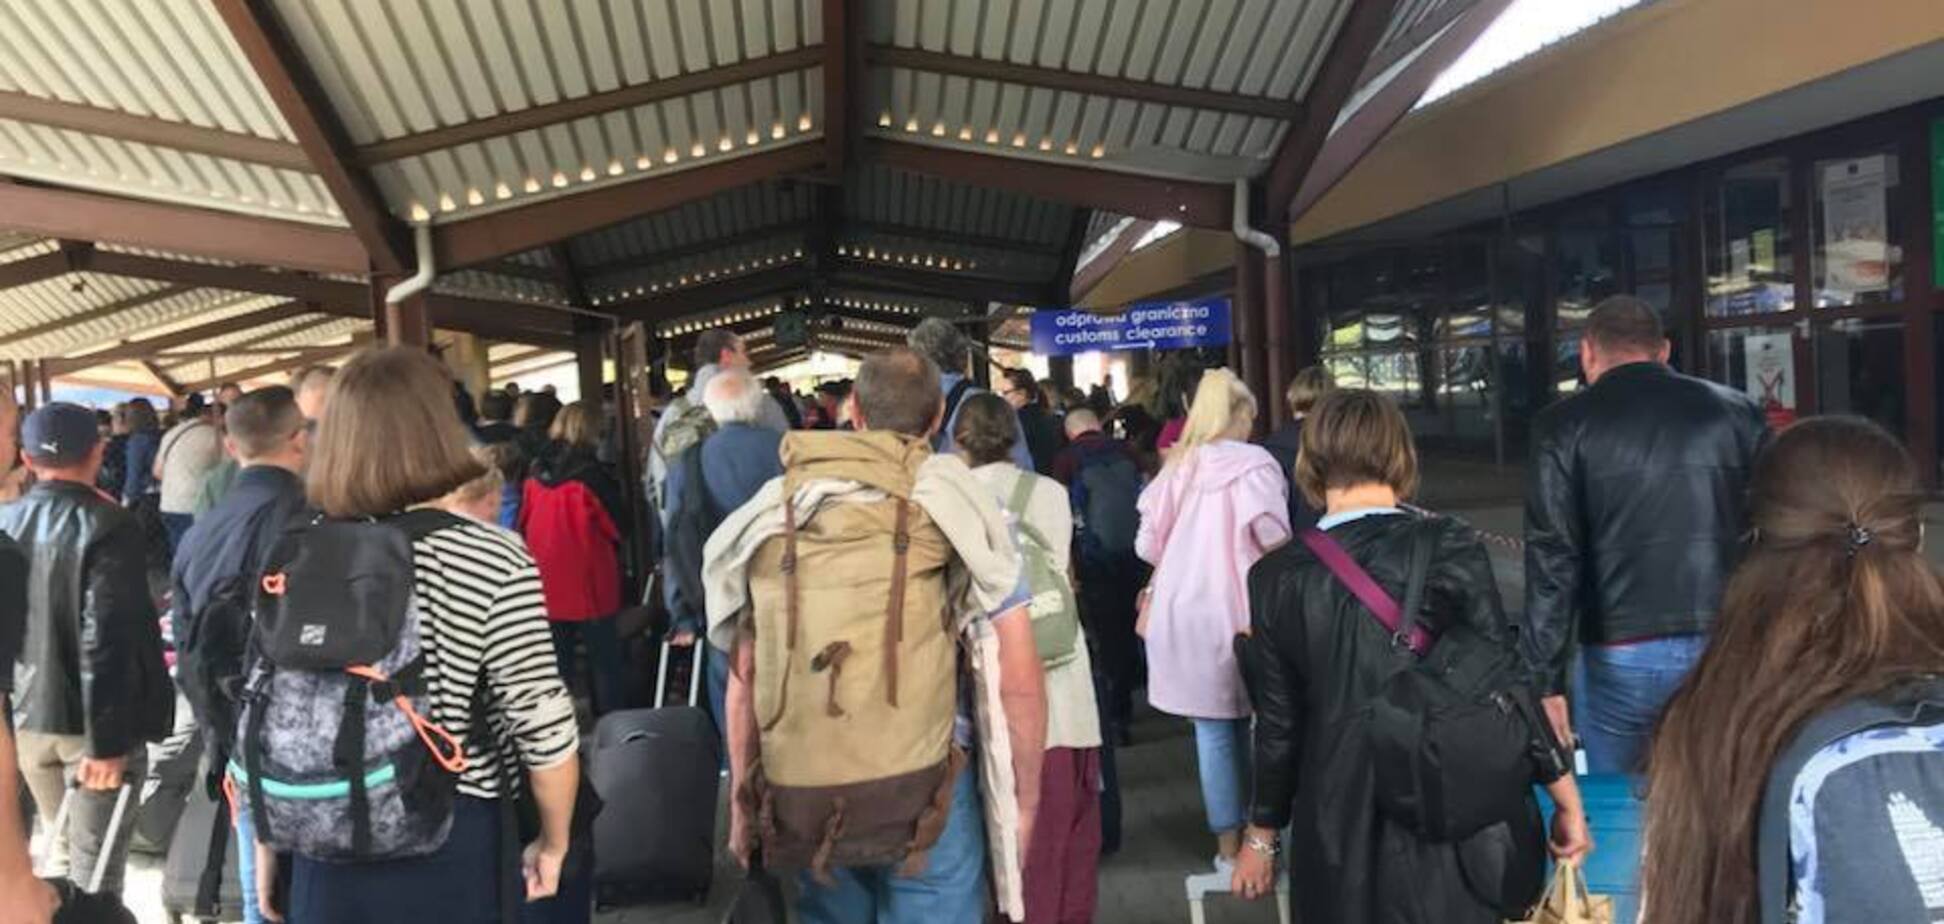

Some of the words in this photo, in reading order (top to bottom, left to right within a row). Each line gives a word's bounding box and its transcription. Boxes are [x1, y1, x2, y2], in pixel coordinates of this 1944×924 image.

[1131, 306, 1209, 325] graniczna
[1055, 330, 1119, 344] customs
[1126, 325, 1207, 341] clearance
